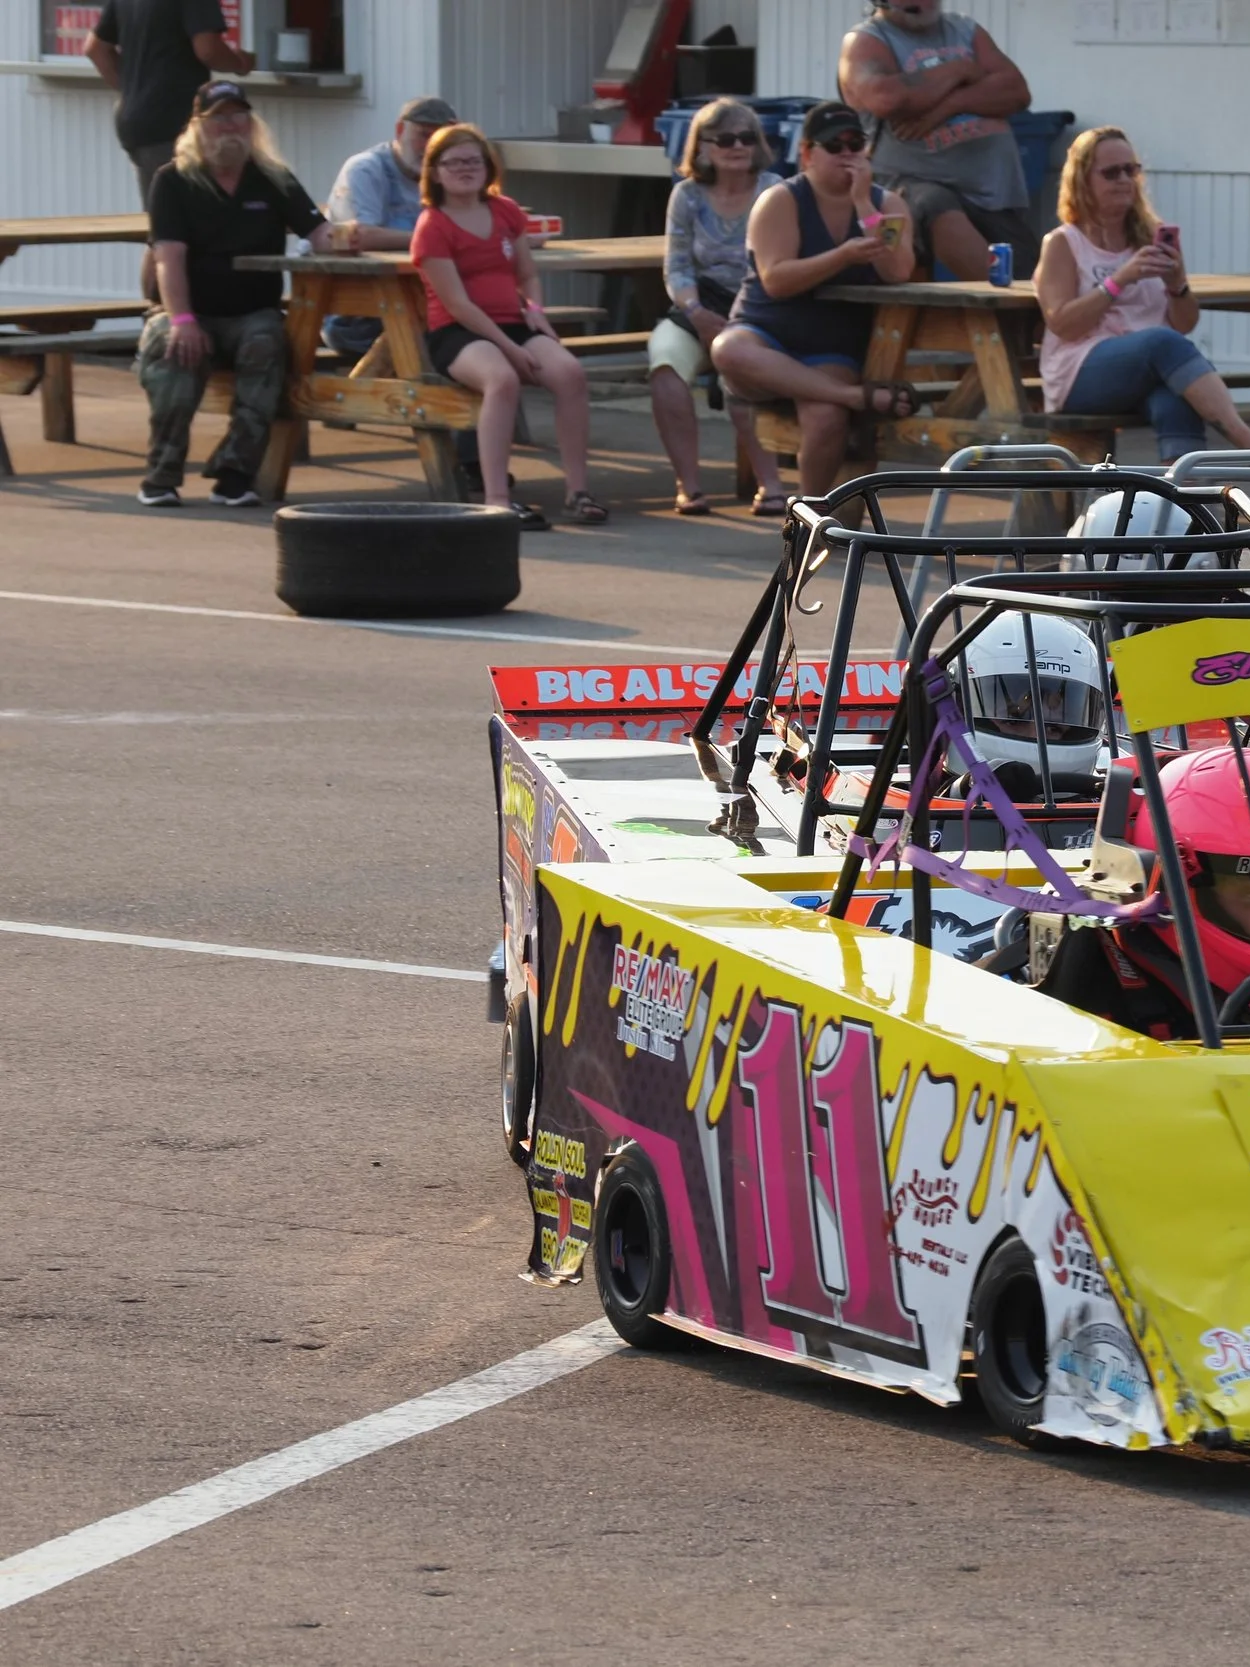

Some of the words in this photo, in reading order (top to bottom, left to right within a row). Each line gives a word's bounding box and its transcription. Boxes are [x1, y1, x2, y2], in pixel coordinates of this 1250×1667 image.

[535, 670, 614, 703] BIG
[622, 665, 720, 701] AL'S
[727, 663, 905, 698] HEATIN
[613, 943, 691, 1013] RE/MAX
[626, 993, 653, 1030] ELITE
[738, 998, 928, 1368] 11
